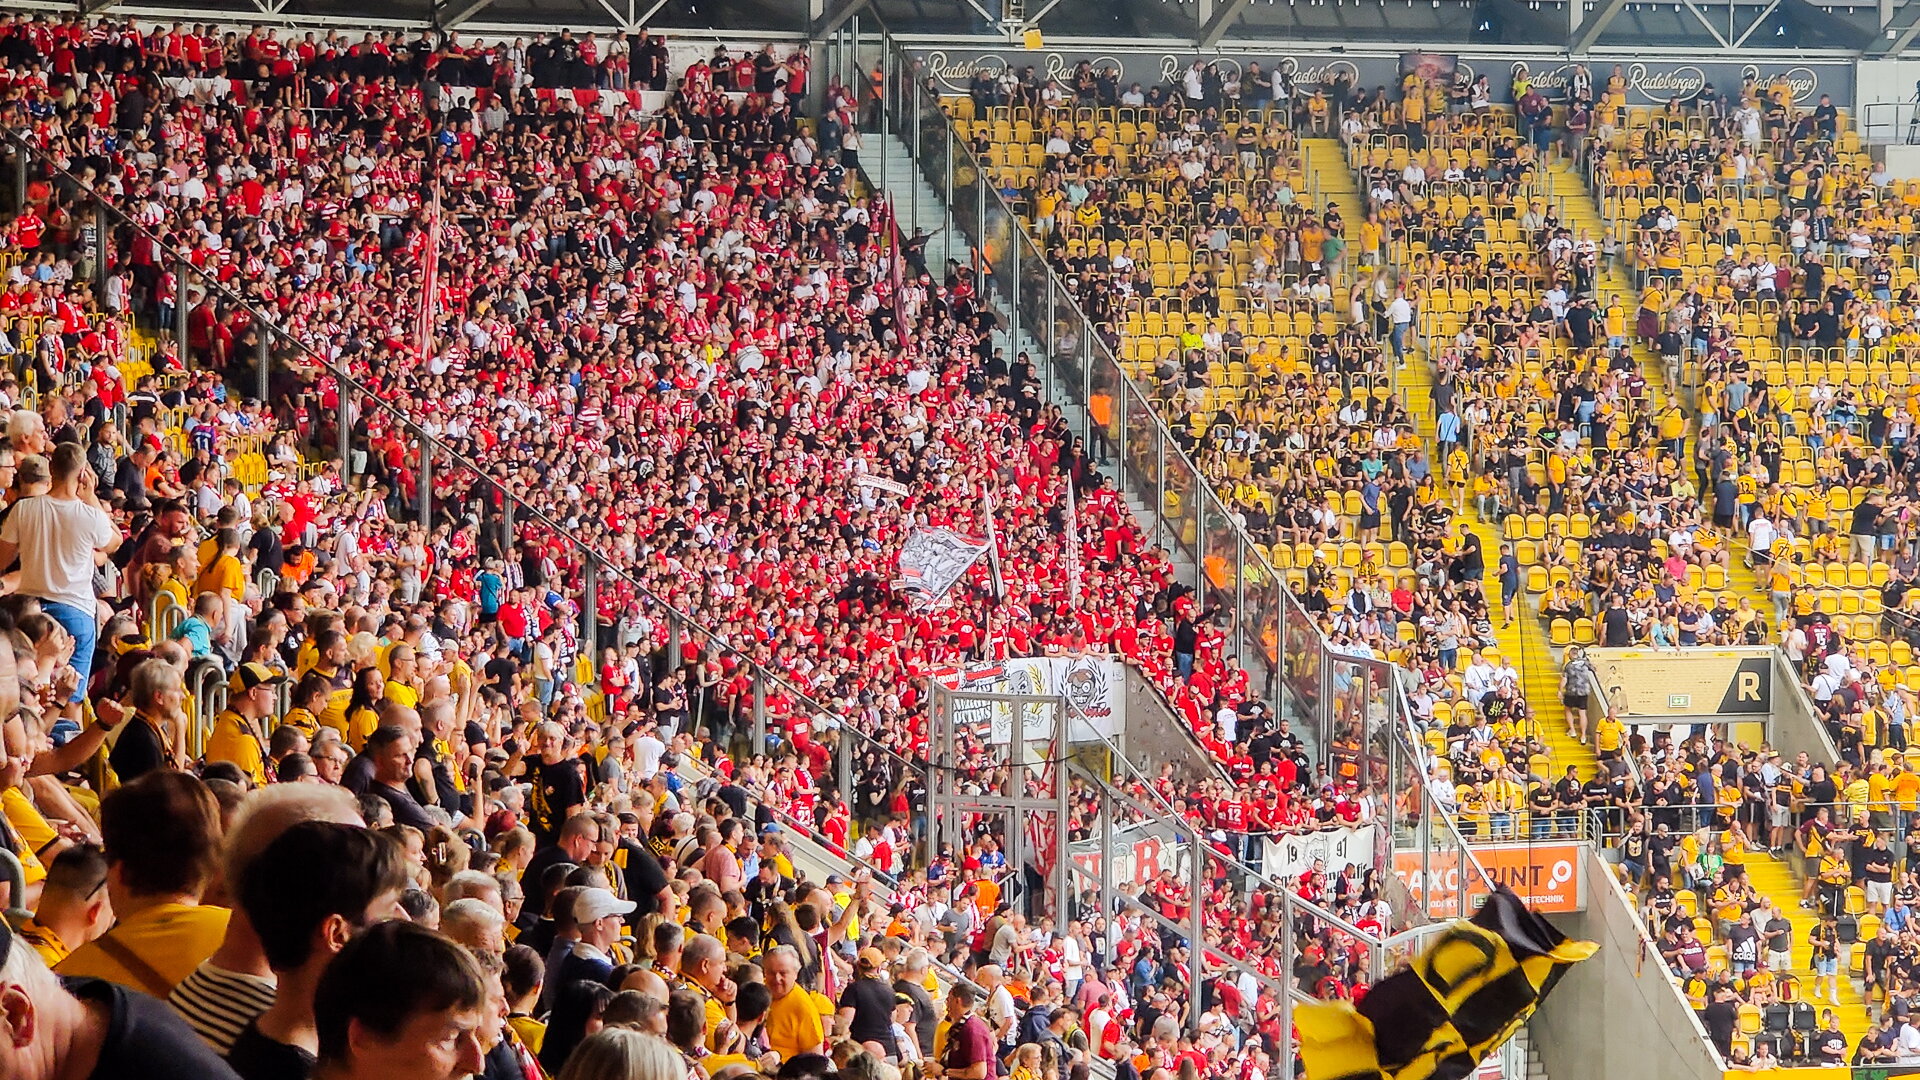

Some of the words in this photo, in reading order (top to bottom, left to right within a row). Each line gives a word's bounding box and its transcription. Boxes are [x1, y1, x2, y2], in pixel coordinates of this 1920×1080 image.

[1628, 63, 1705, 103] Radeberger
[1738, 671, 1761, 701] R
[1228, 808, 1241, 822] 12
[1133, 839, 1160, 886] R
[1287, 843, 1297, 865] 19
